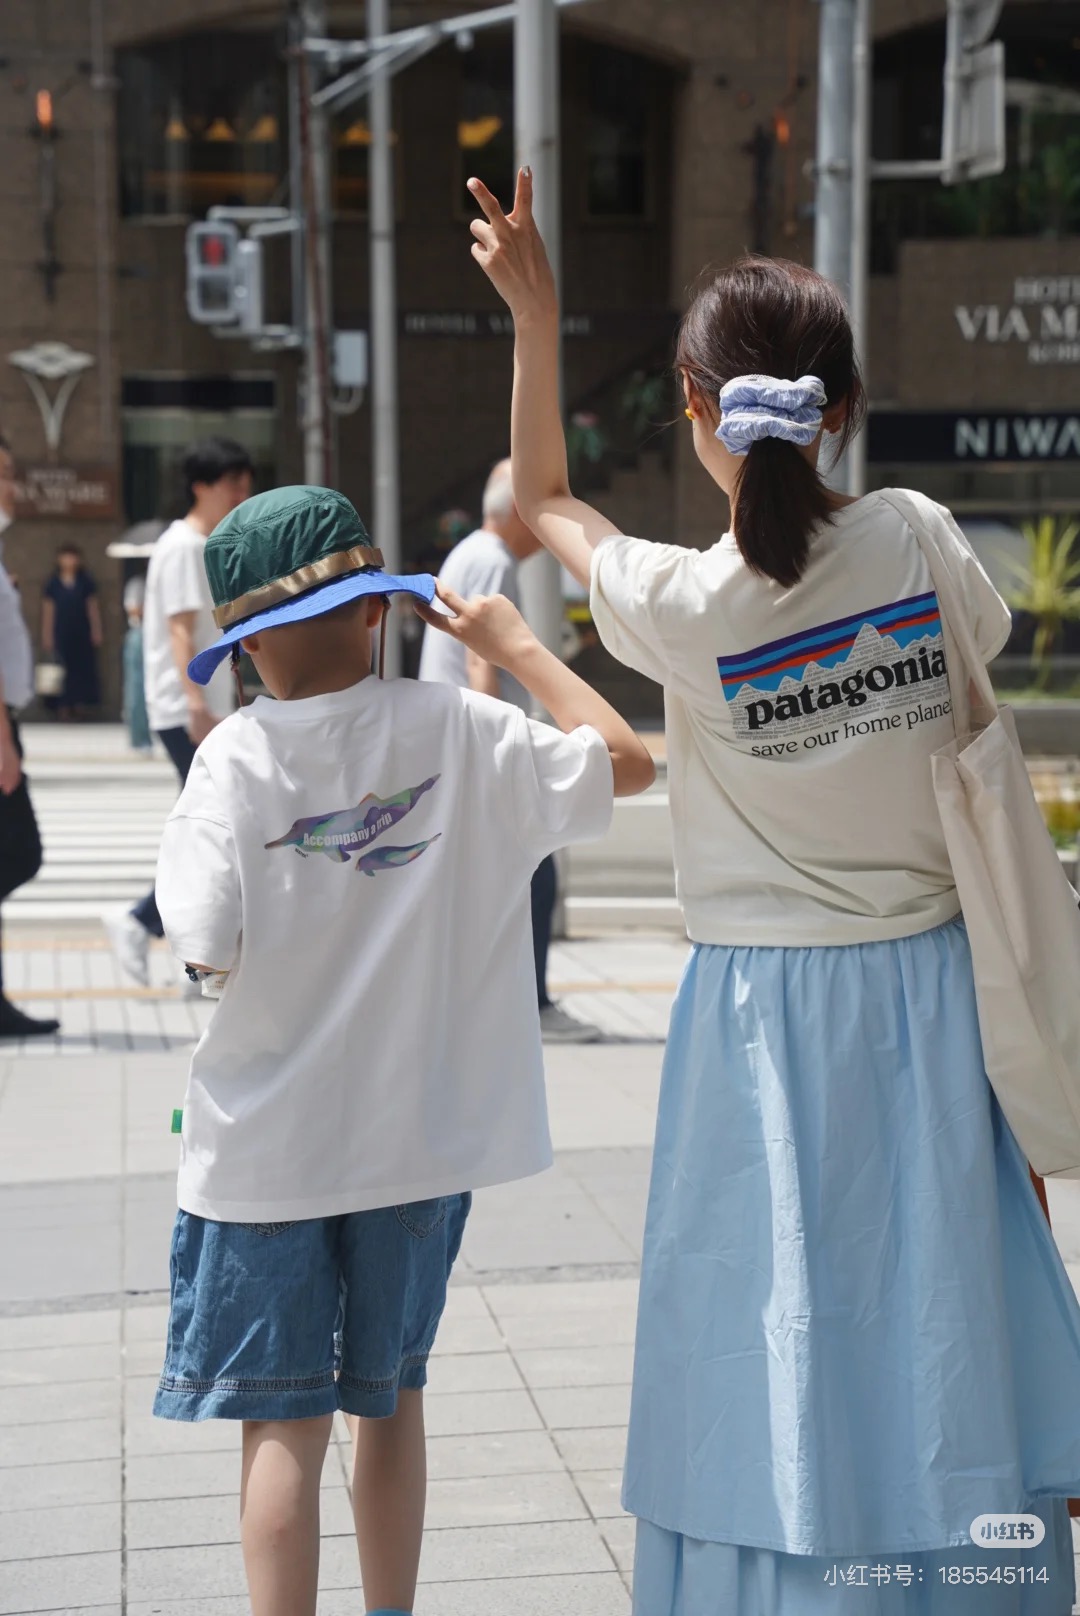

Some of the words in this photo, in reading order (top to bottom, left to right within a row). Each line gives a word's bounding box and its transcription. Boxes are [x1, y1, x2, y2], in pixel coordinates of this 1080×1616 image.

[955, 305, 1030, 341] VIA
[1041, 305, 1080, 340] M
[744, 646, 947, 730] patagonia
[751, 739, 799, 757] save
[803, 728, 840, 749] our
[843, 713, 902, 740] home
[303, 828, 370, 846] Accompany
[370, 825, 376, 835] a
